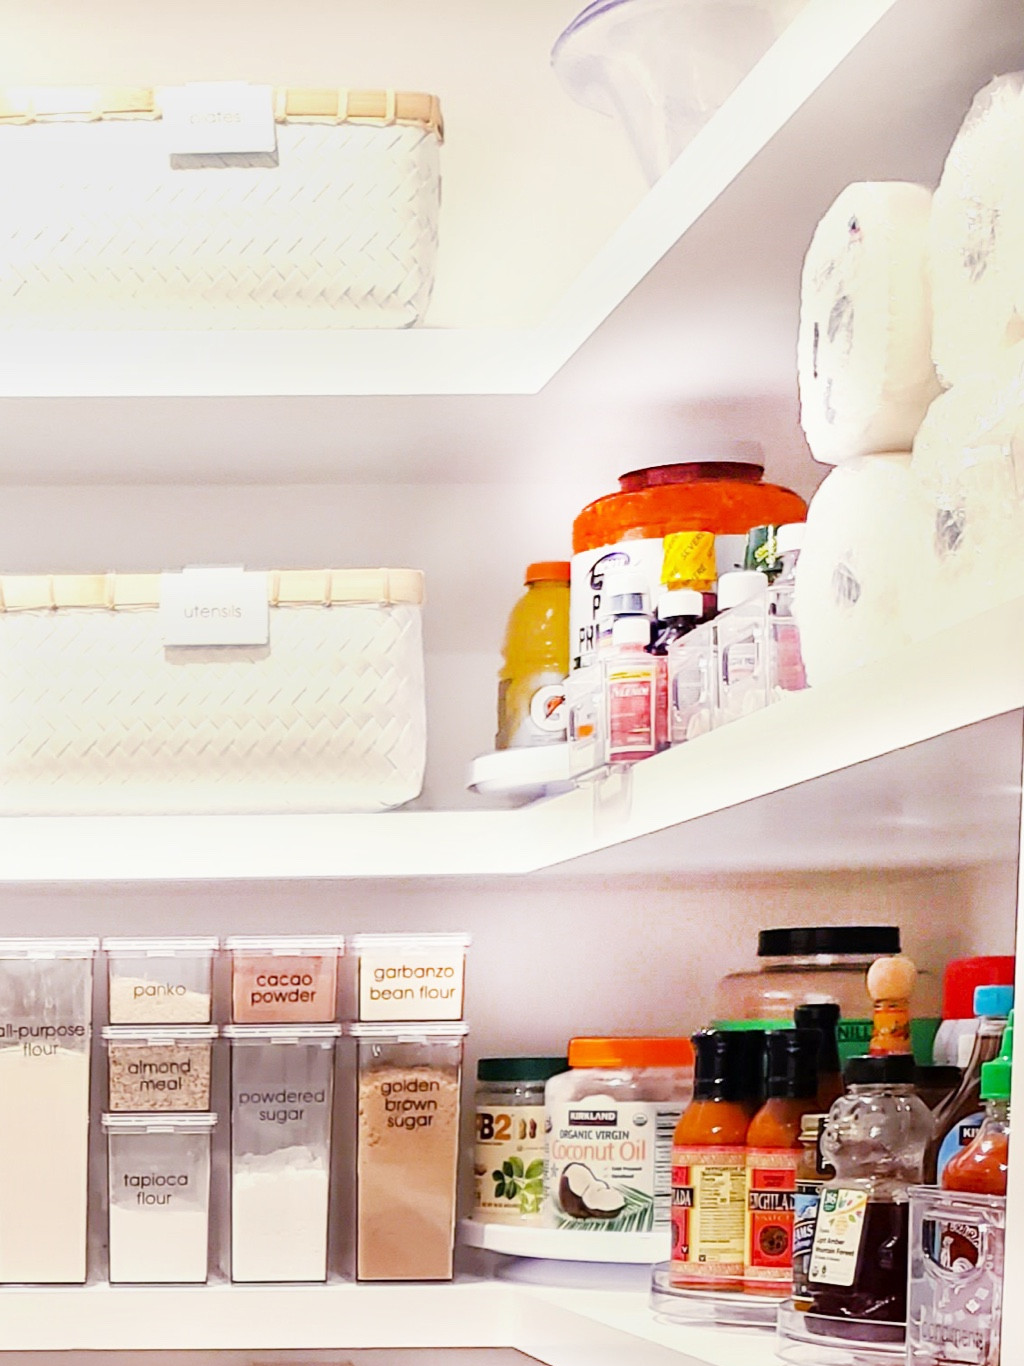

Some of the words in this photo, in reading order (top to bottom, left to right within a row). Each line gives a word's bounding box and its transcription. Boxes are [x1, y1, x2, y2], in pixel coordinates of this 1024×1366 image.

[183, 603, 243, 620] utensils
[256, 974, 313, 988] cacao
[374, 965, 455, 984] garbanzo
[133, 982, 187, 1000] panko
[251, 988, 317, 1005] powder
[370, 985, 415, 1000] bean
[418, 984, 456, 1000] flour
[22, 1041, 59, 1057] flour
[127, 1059, 192, 1075] almond
[140, 1075, 183, 1092] meal
[380, 1079, 441, 1097] golden
[239, 1088, 325, 1106] powdered
[384, 1099, 438, 1113] brown
[258, 1107, 305, 1124] sugar
[387, 1113, 435, 1130] sugar
[570, 1112, 616, 1121] KIRKLAND
[559, 1130, 592, 1139] ORGANIC
[595, 1130, 630, 1140] VIRGIN
[551, 1140, 615, 1161] Coconut
[619, 1140, 647, 1162] Oil
[123, 1173, 188, 1190] tapioca
[136, 1191, 173, 1206] flour
